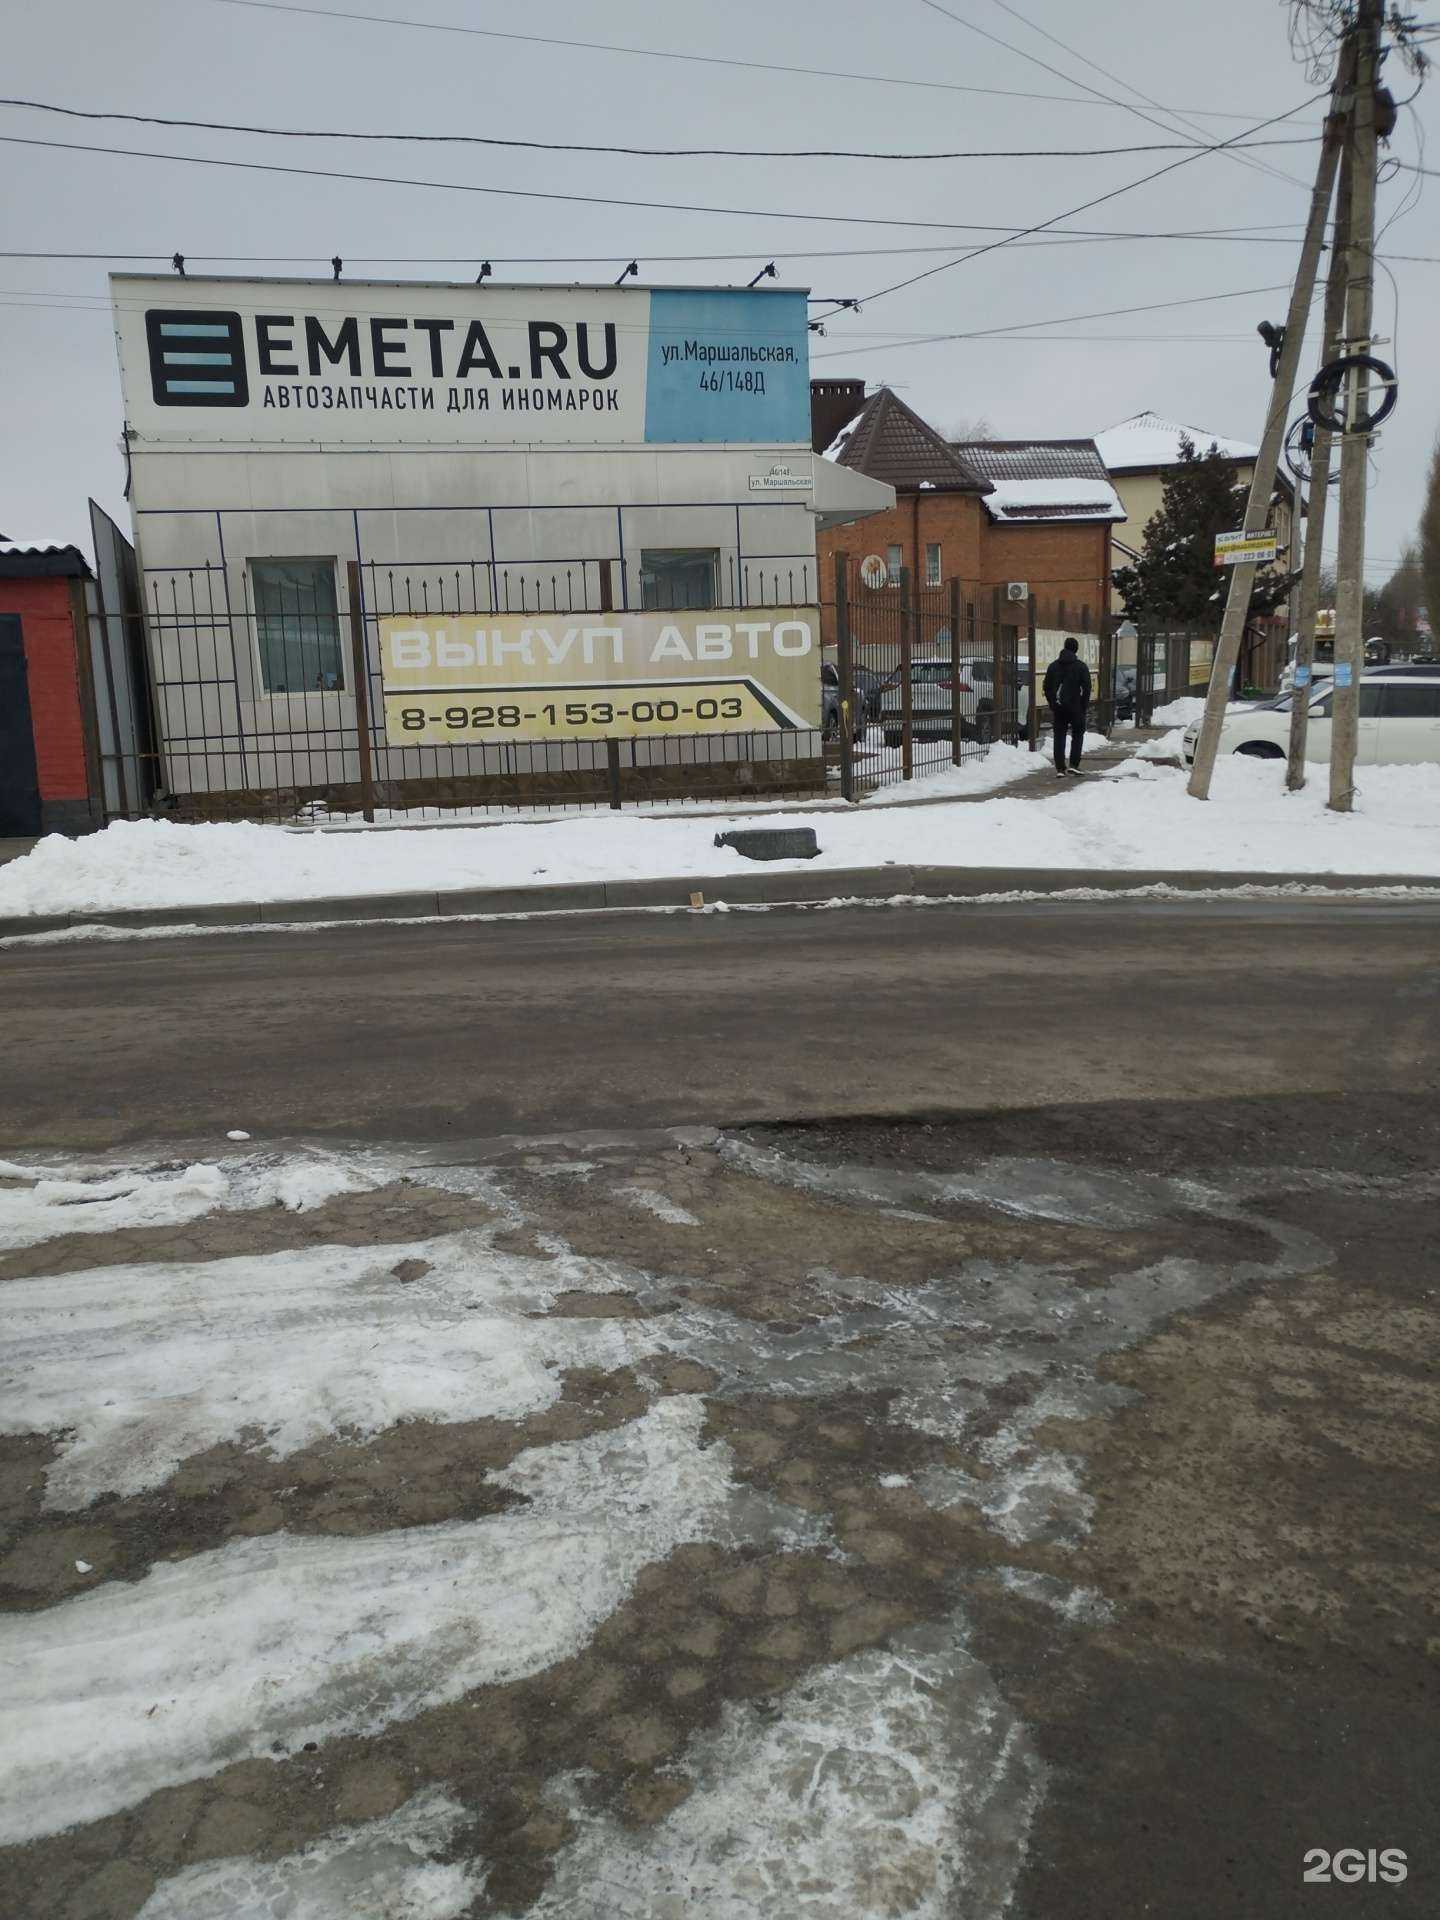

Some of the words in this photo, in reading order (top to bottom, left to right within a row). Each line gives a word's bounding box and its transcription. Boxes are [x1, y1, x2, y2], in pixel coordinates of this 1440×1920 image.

[254, 314, 618, 380] EMETA.RU
[661, 340, 799, 366] ул.Маршальская,
[699, 370, 766, 395] 46/148Д
[263, 384, 435, 411] АВТОЗАПЧАСТИ
[446, 387, 490, 414] ДЛЯ
[502, 387, 620, 412] ИНОМАРОК
[389, 627, 624, 669] ВЫКУП
[649, 621, 812, 661] АВТО
[401, 697, 743, 731] 8-928-153-00-03
